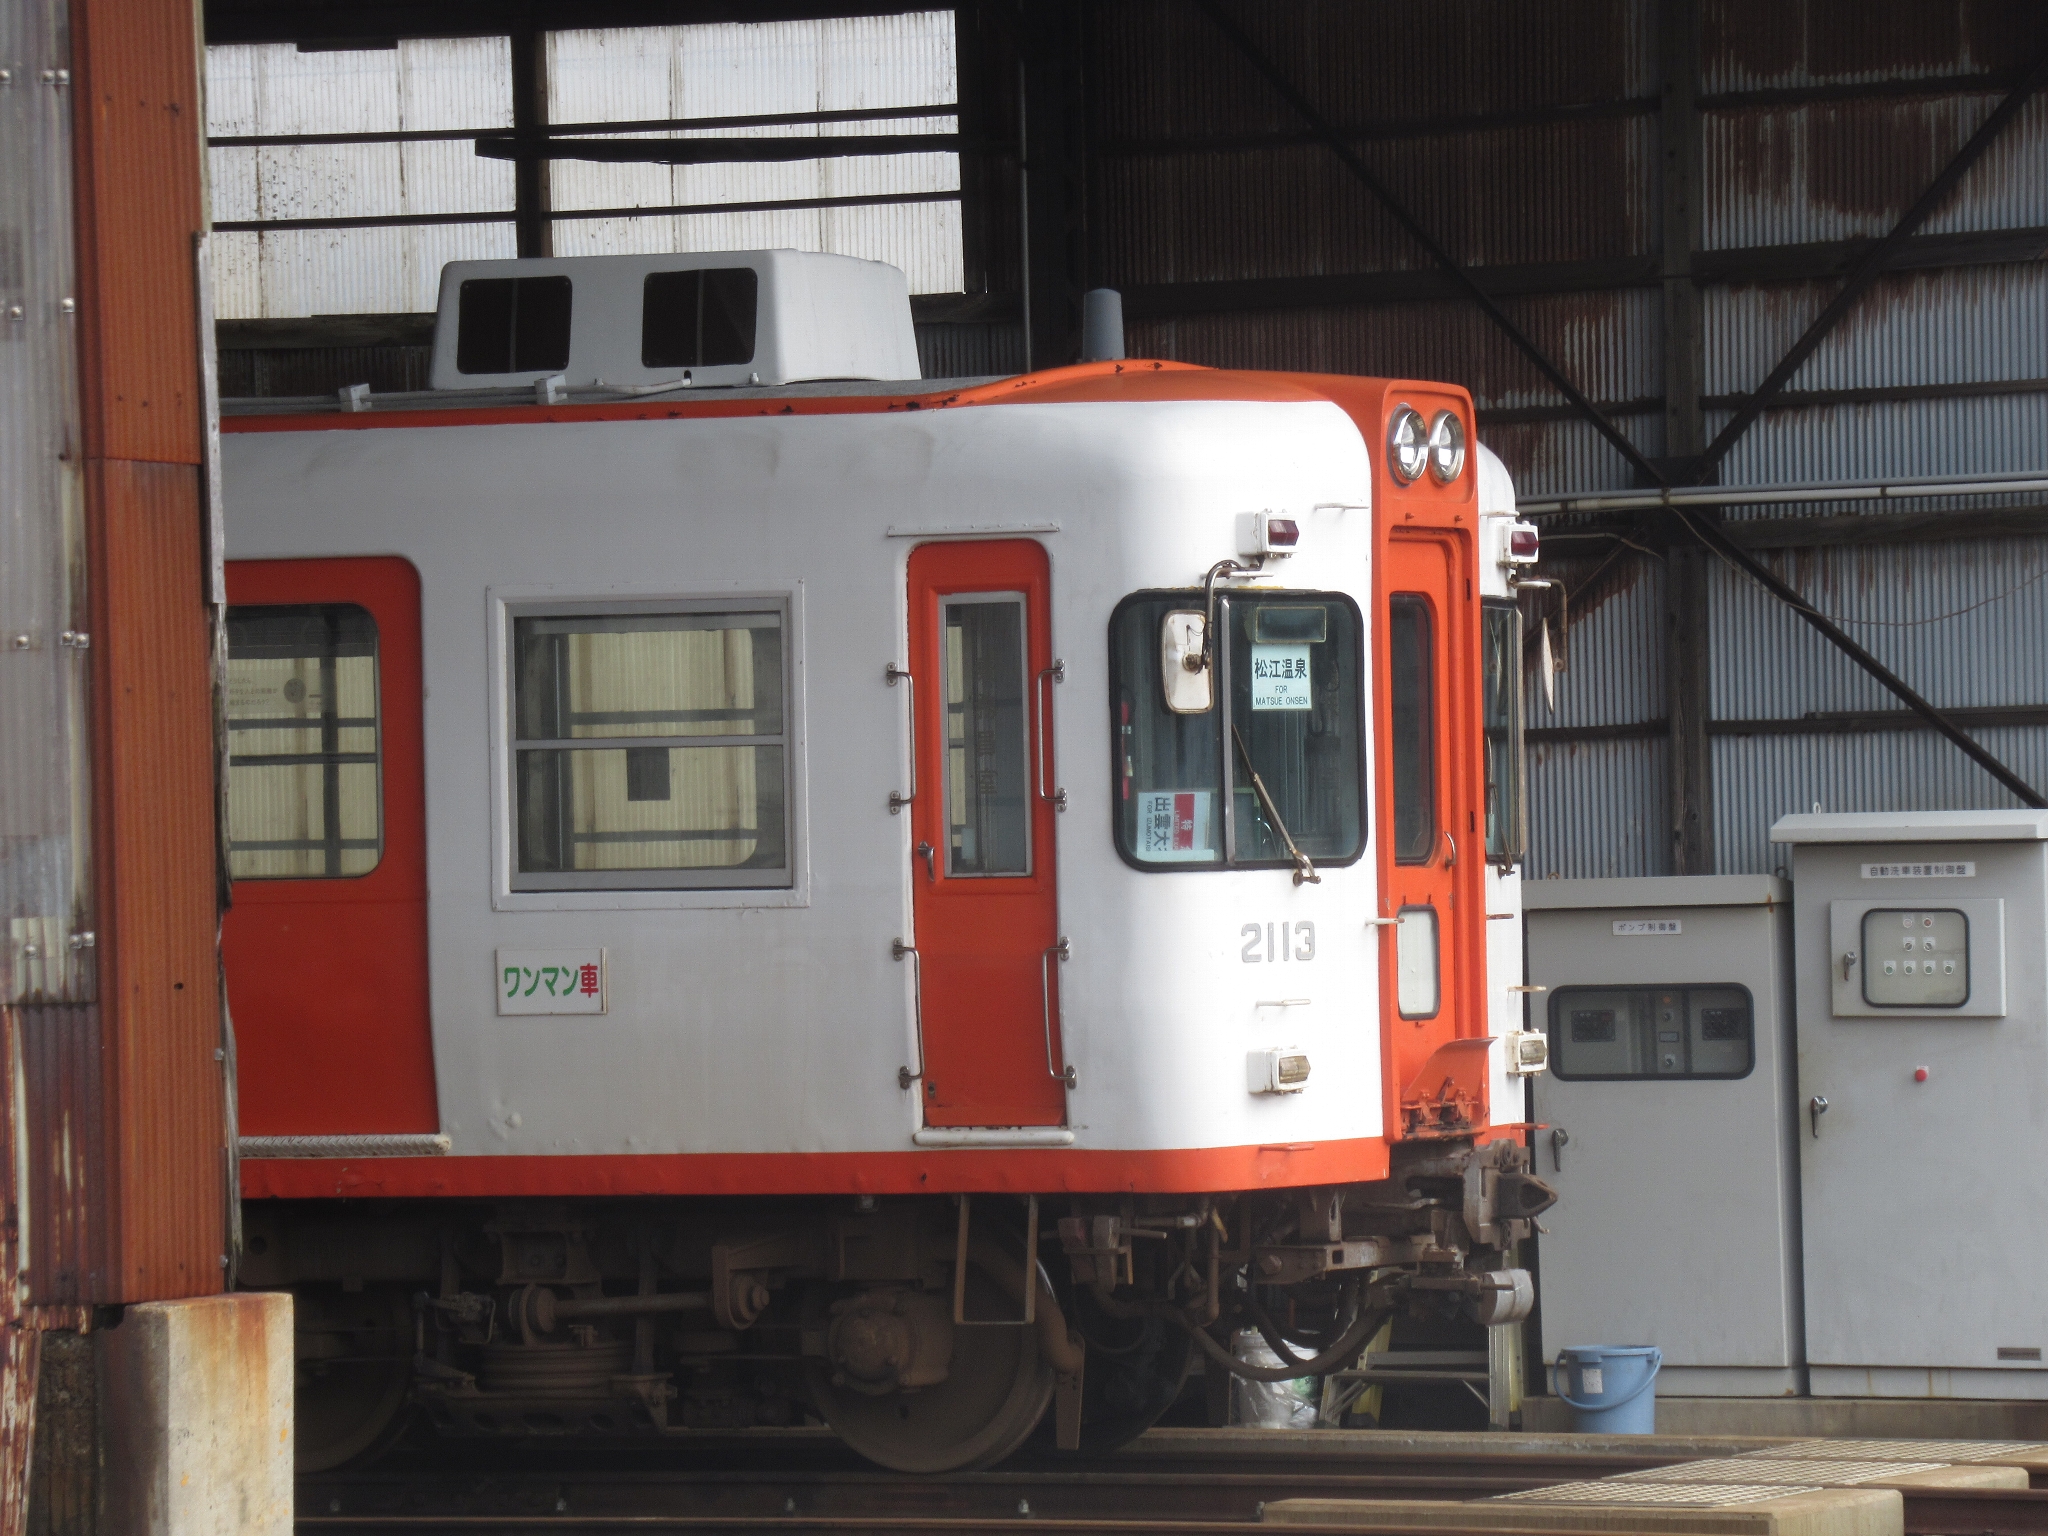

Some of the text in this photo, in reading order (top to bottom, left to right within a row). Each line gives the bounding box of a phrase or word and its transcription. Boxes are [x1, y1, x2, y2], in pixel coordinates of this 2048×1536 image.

[1254, 657, 1308, 680] 松江温泉
[1275, 685, 1288, 694] FOR
[1255, 696, 1308, 706] MATSUE ONSEN
[1869, 864, 1966, 877] 自動洗車装置制御盤
[1618, 922, 1677, 932] ポンプ制御盤
[1240, 920, 1316, 963] 2113
[504, 963, 599, 999] ワンマン車
